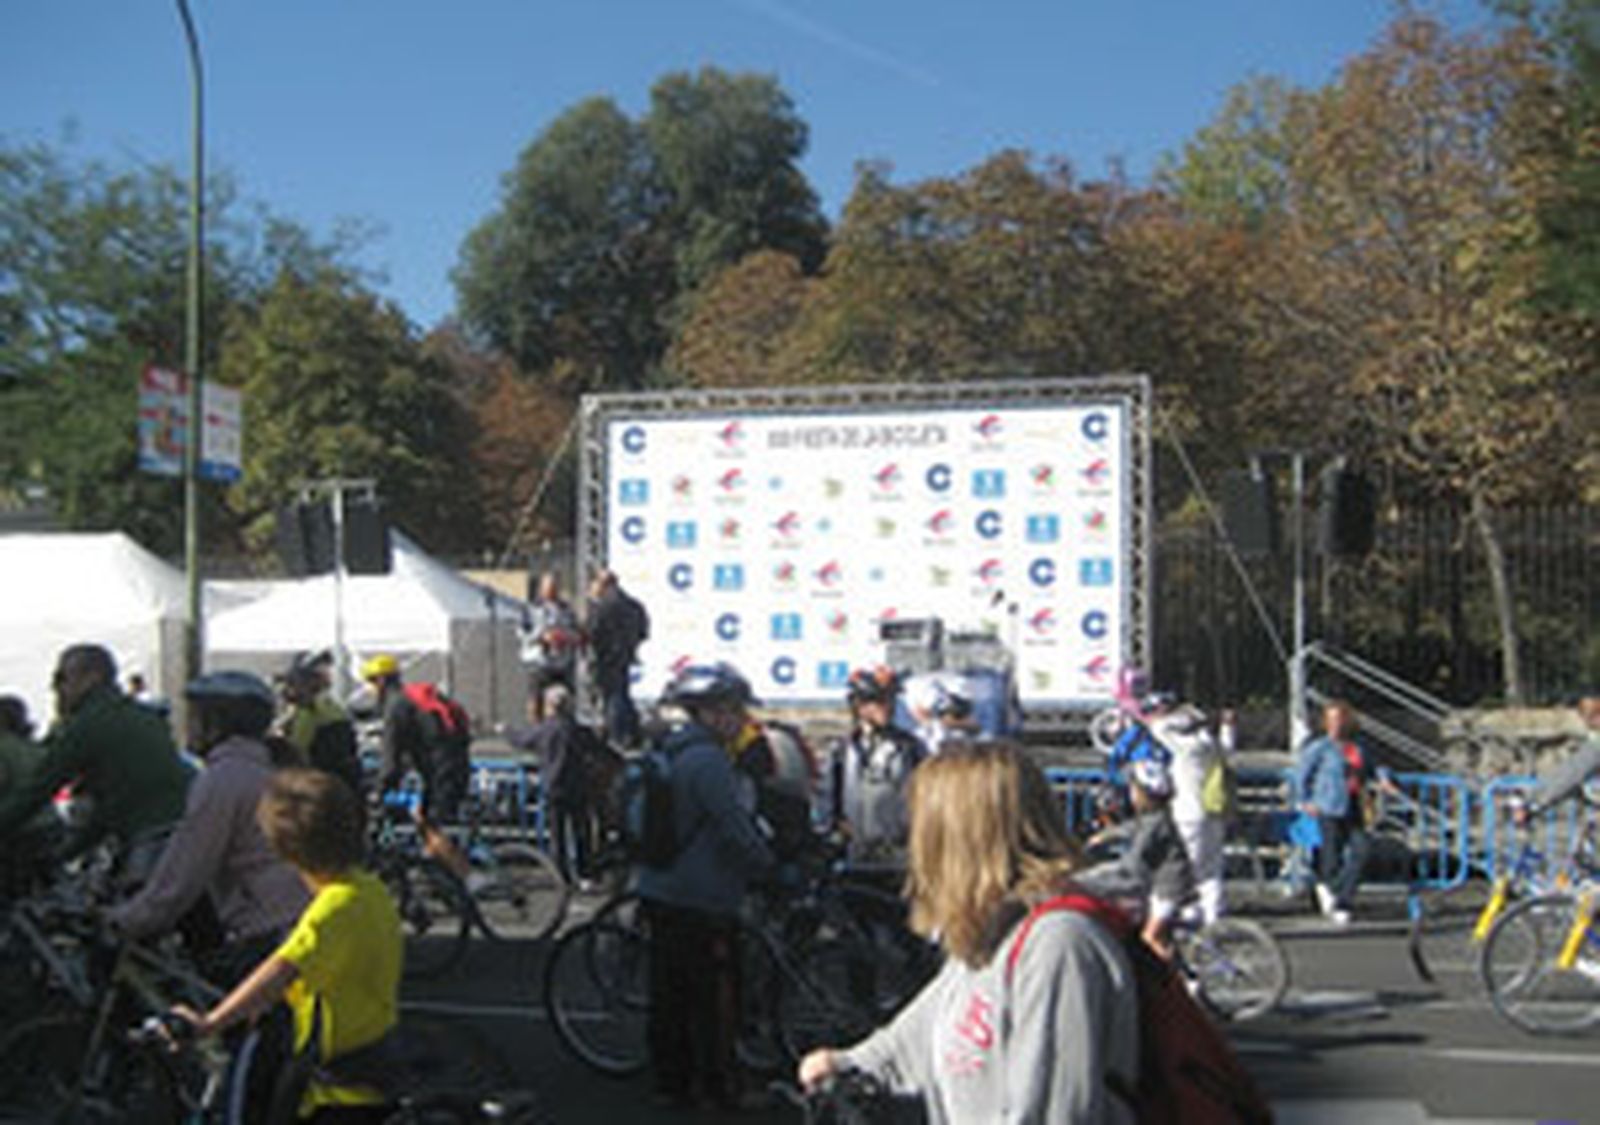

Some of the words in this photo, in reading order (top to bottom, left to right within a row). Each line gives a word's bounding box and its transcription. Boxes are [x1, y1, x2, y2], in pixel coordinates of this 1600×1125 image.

[621, 426, 646, 454] C
[1081, 413, 1109, 440] C
[925, 463, 952, 492] C
[620, 516, 646, 544] C
[975, 510, 1002, 539] C
[667, 562, 693, 591] C
[1028, 558, 1056, 587] C
[715, 612, 740, 641] C
[1081, 610, 1108, 639] C
[771, 656, 796, 685] C
